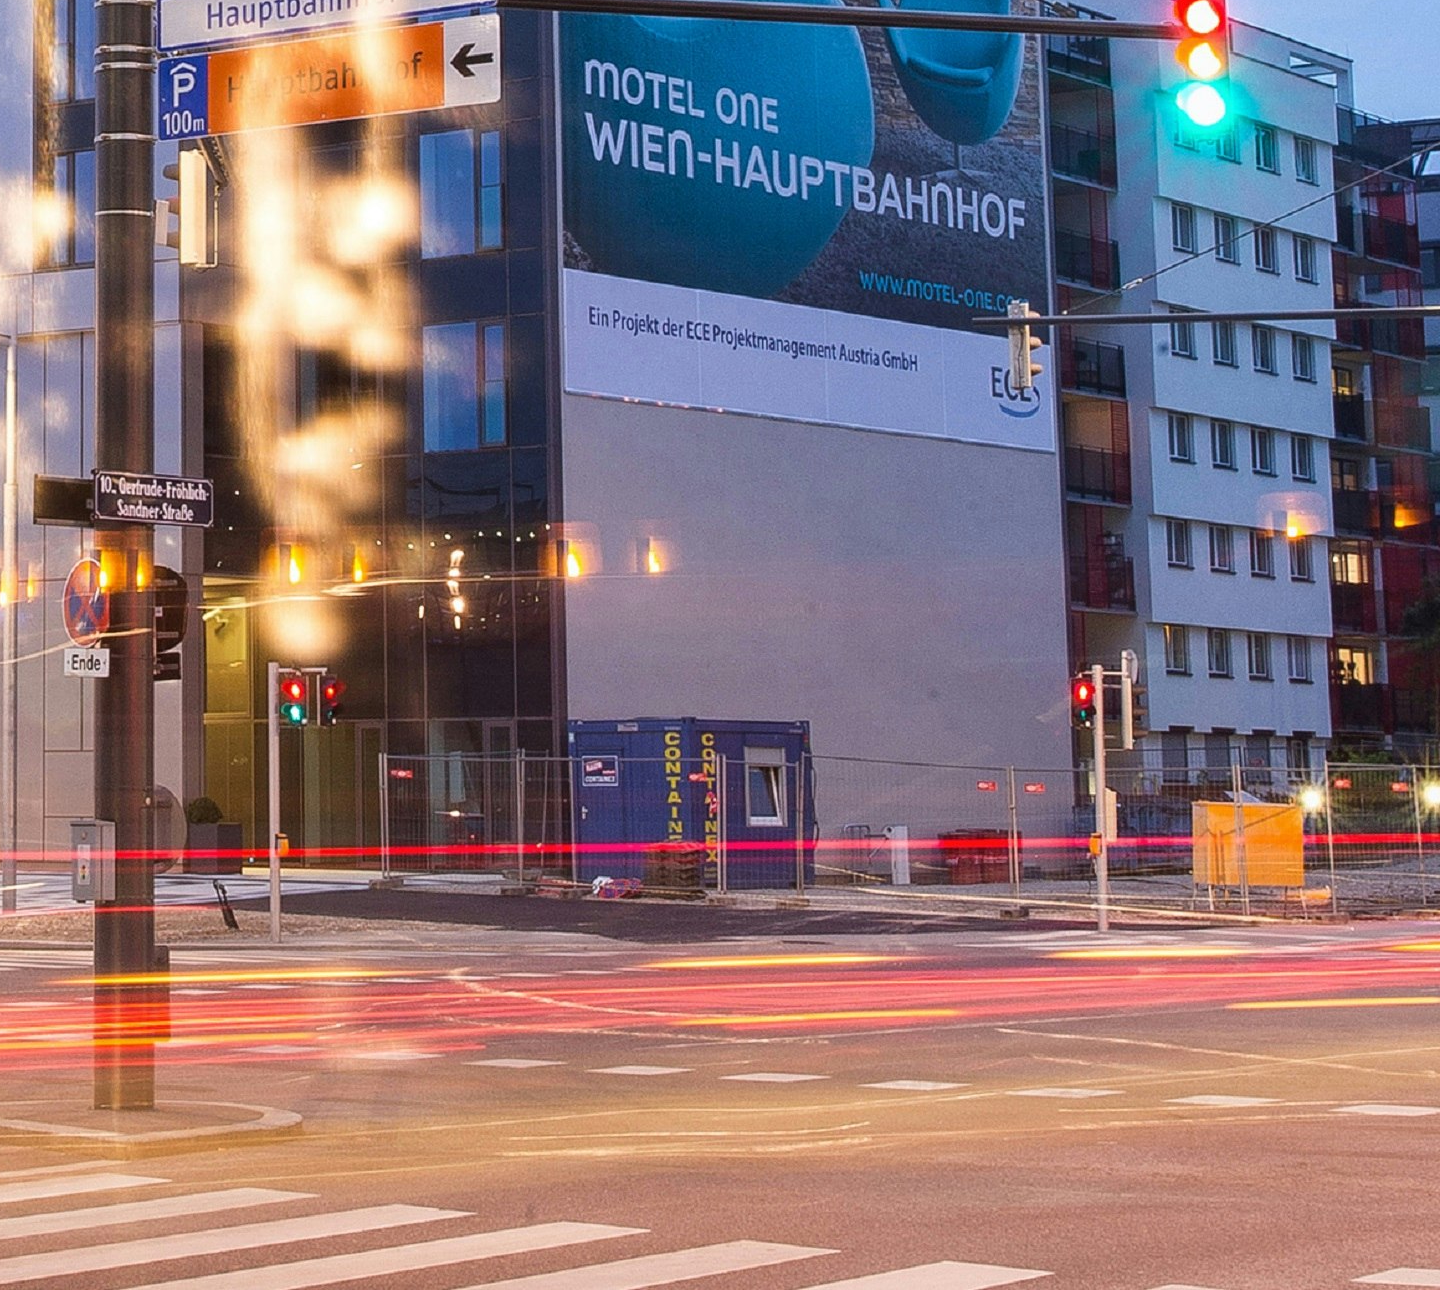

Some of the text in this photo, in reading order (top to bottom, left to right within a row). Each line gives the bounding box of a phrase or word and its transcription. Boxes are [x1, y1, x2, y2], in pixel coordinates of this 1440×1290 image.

[583, 58, 779, 135] MOTEL ONE
[584, 111, 1027, 241] WIEN-HAUPTBAHNHOF
[588, 305, 918, 372] Ein Projekt der ECE Projektmanagement Austria GmbH
[990, 365, 1033, 403] EC
[71, 654, 102, 671] Ende
[664, 731, 684, 841] CONTAIN
